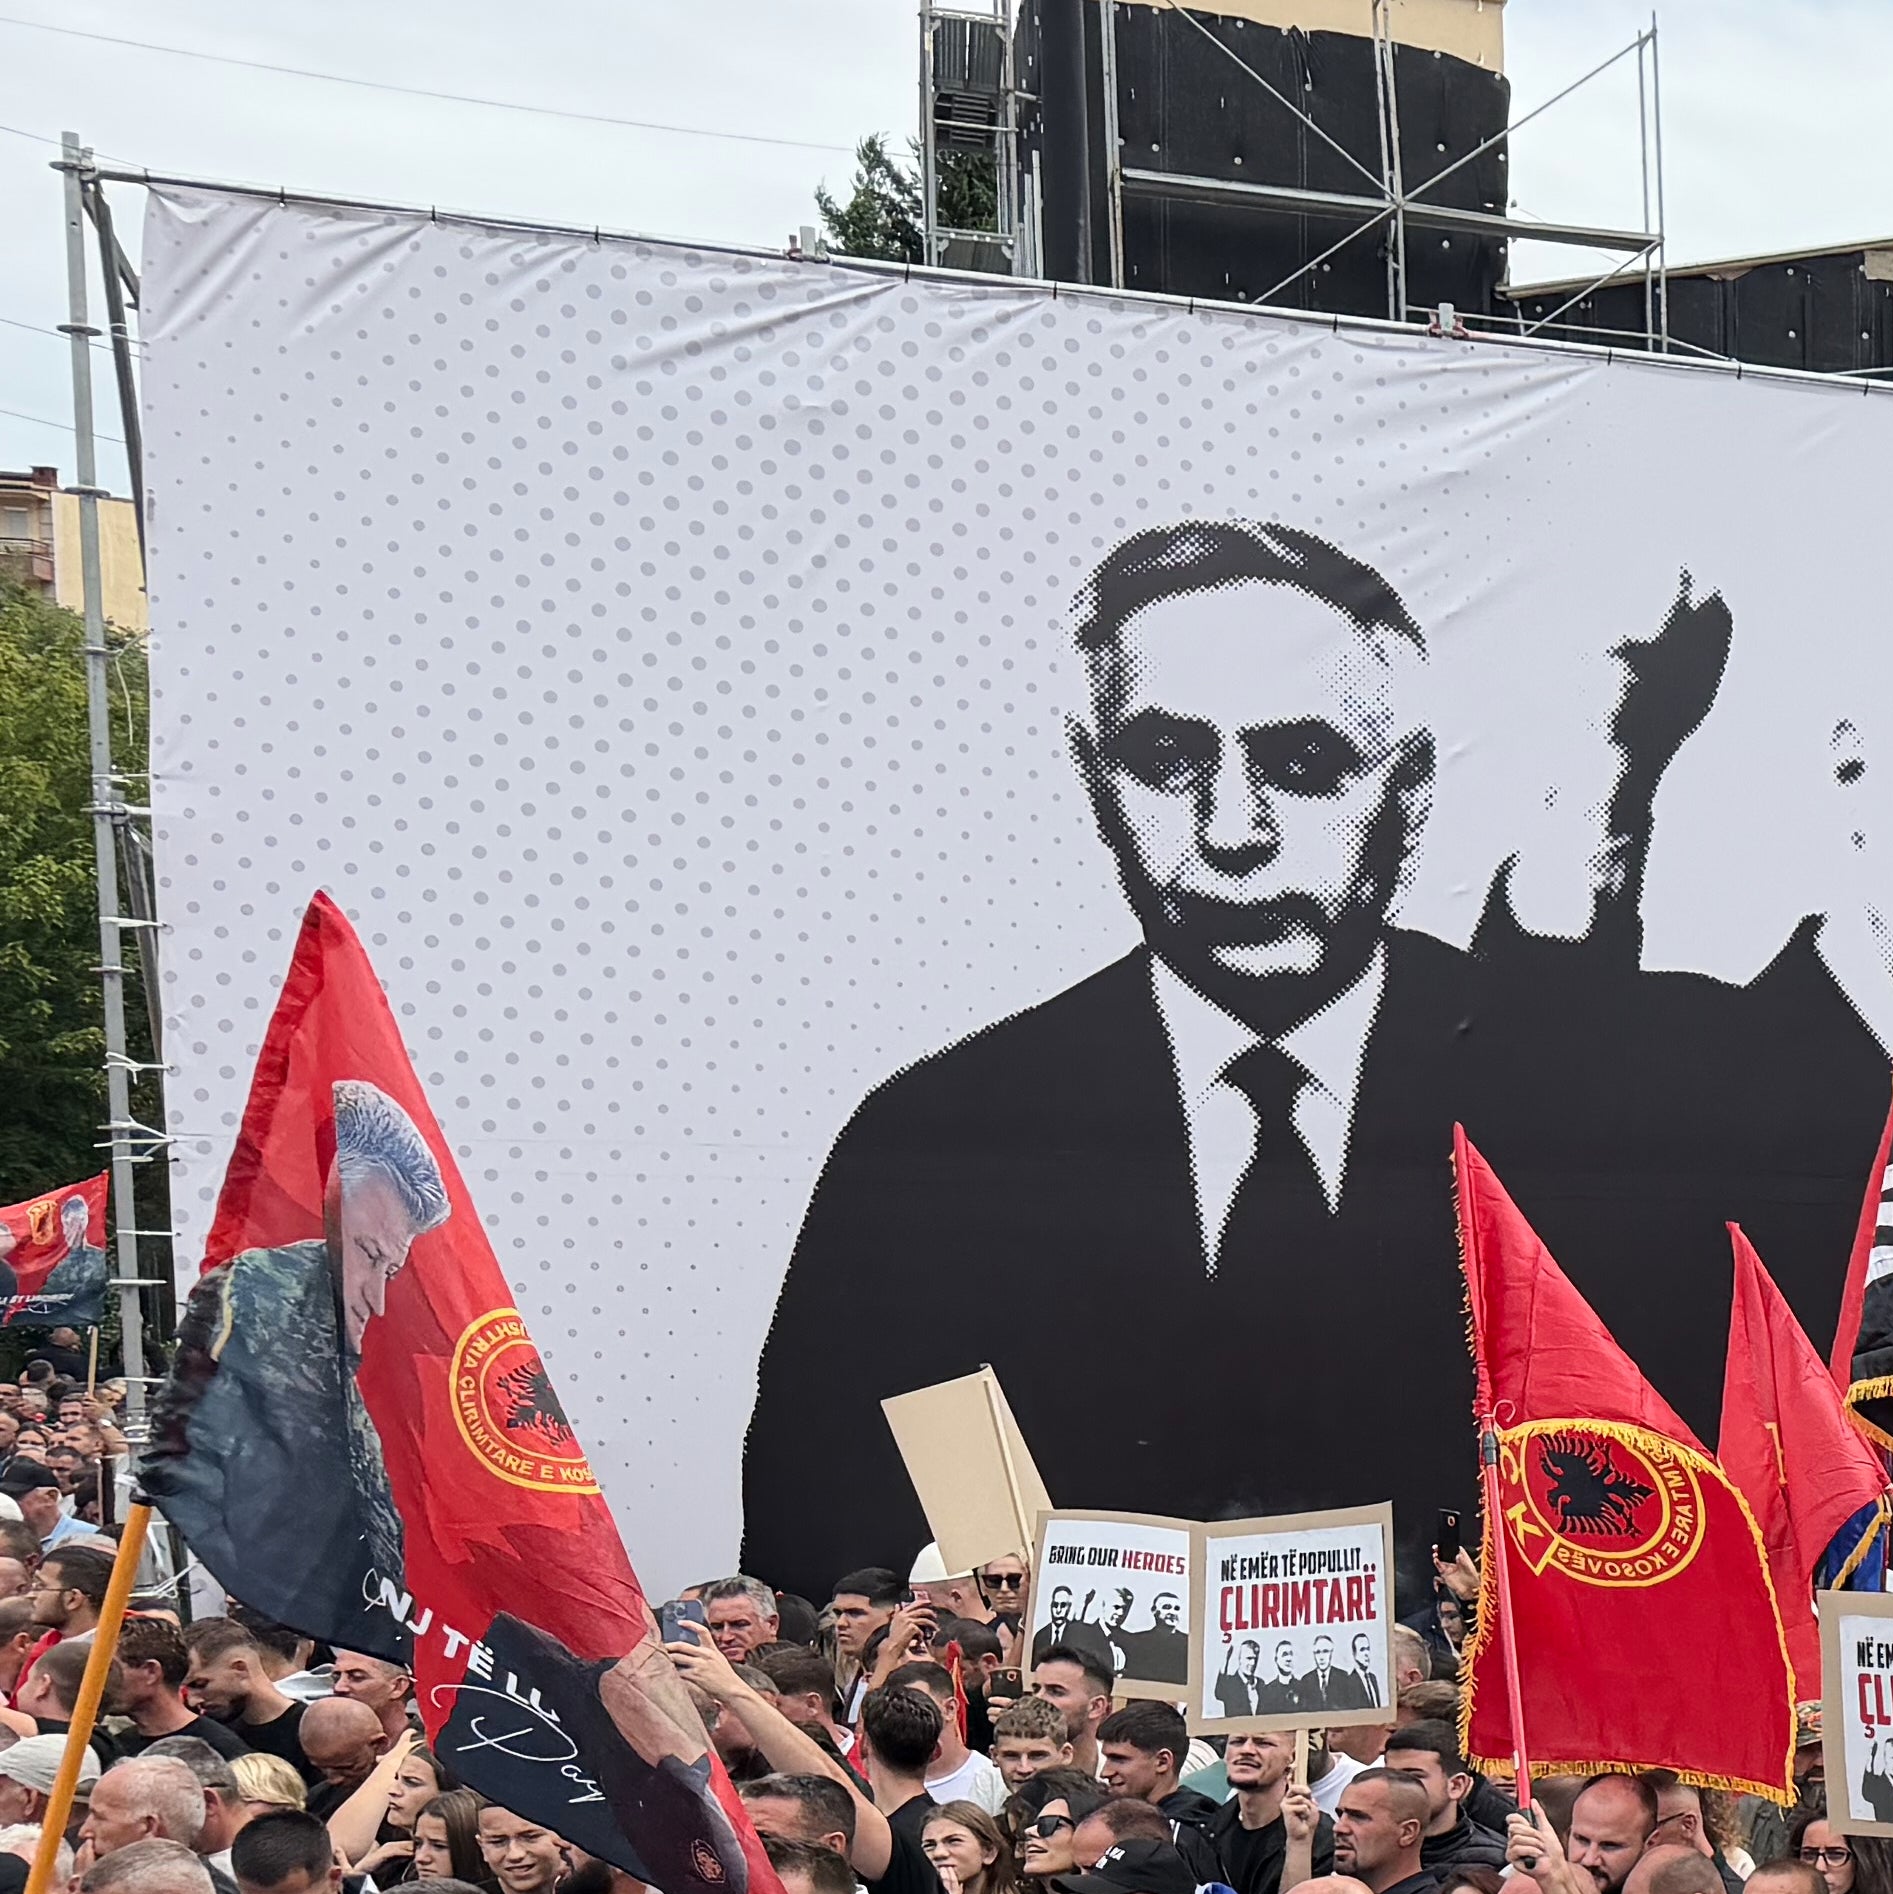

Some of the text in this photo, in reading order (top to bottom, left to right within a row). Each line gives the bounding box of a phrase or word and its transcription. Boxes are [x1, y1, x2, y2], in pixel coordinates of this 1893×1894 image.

[1049, 1545, 1186, 1575] BRING OUR HEROES
[1221, 1547, 1361, 1582] NË EMËR TË POPULLIT
[1219, 1563, 1377, 1643] ÇLIRIMTARË
[1857, 1636, 1874, 1668] NË
